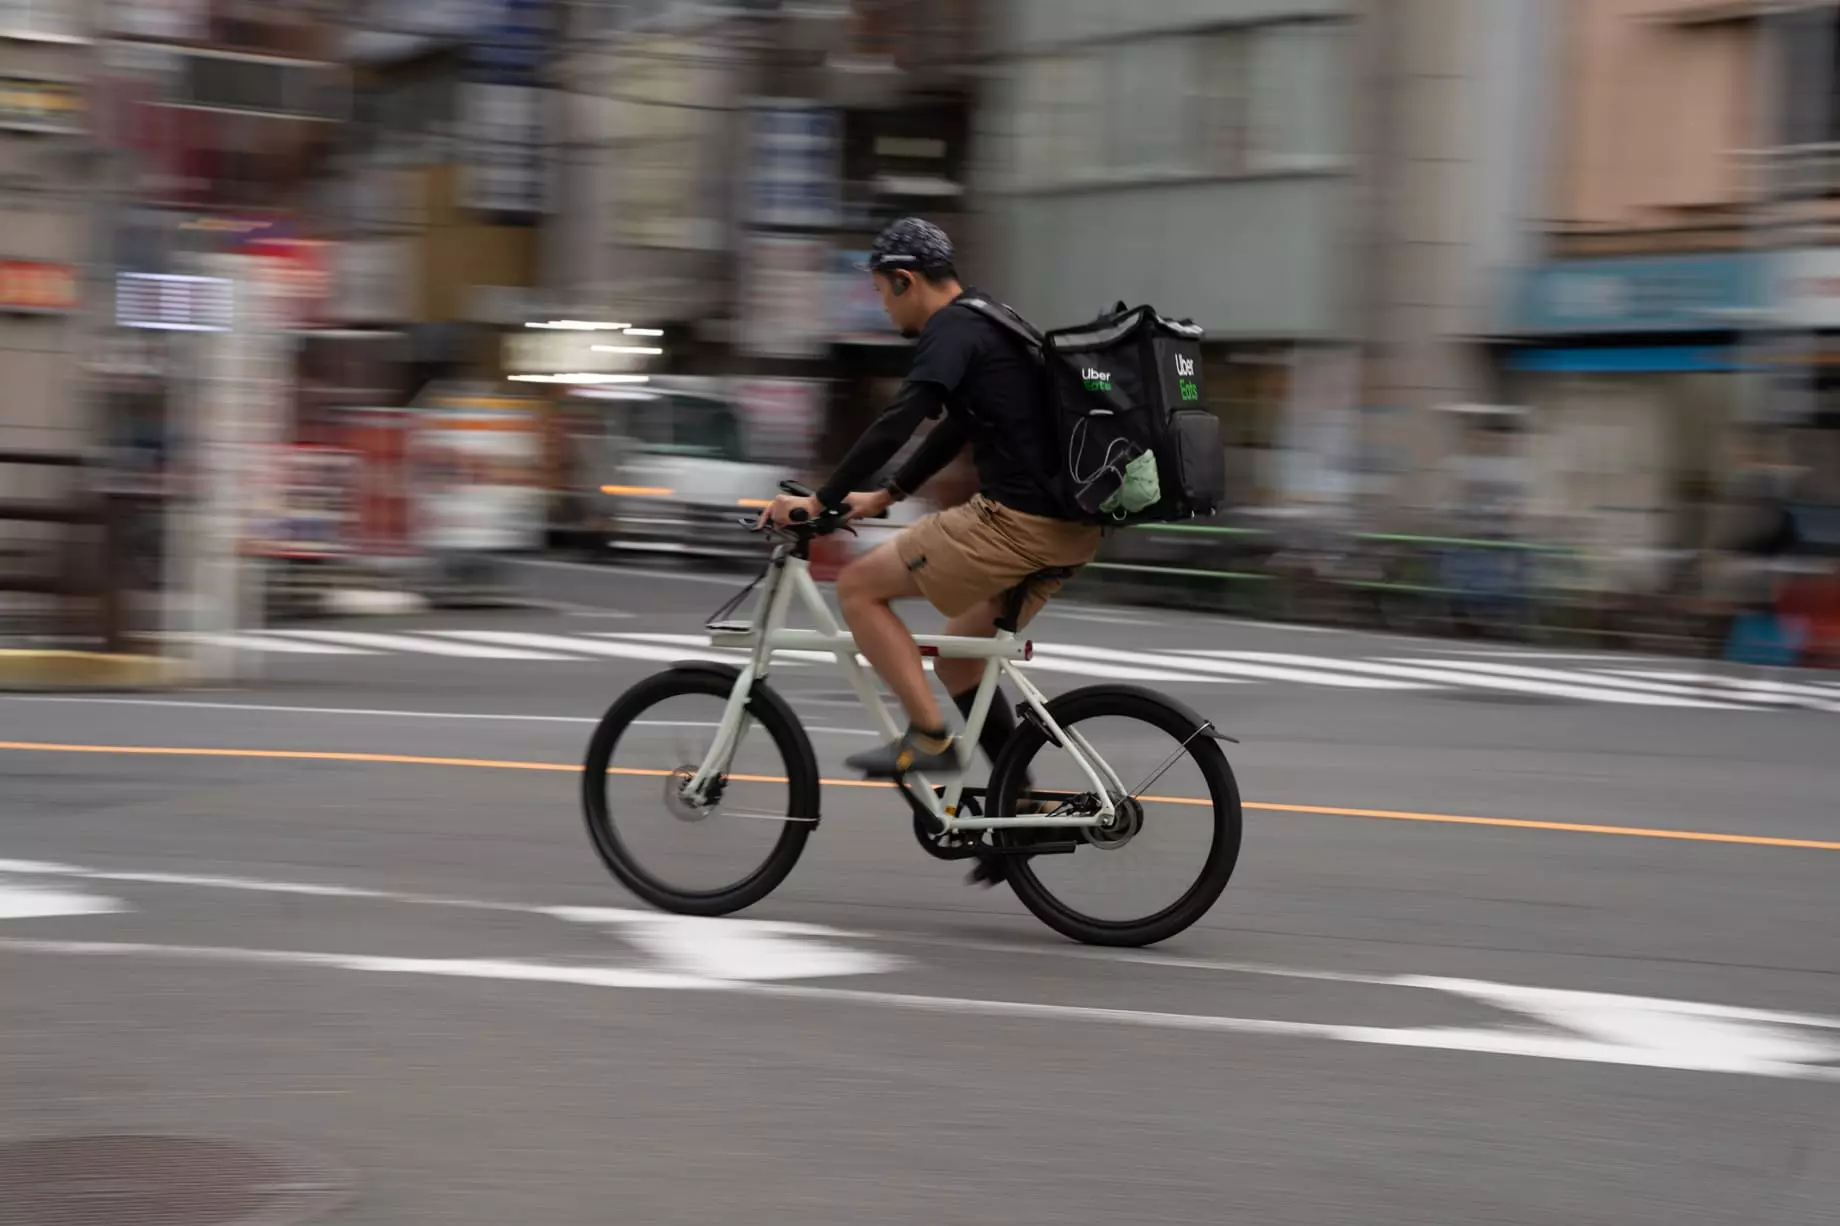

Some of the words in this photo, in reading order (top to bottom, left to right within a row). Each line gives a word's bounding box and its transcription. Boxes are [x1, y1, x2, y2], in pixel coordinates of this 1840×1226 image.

[1082, 367, 1111, 381] Uber
[1175, 353, 1195, 377] Uber
[1179, 379, 1198, 401] Eats
